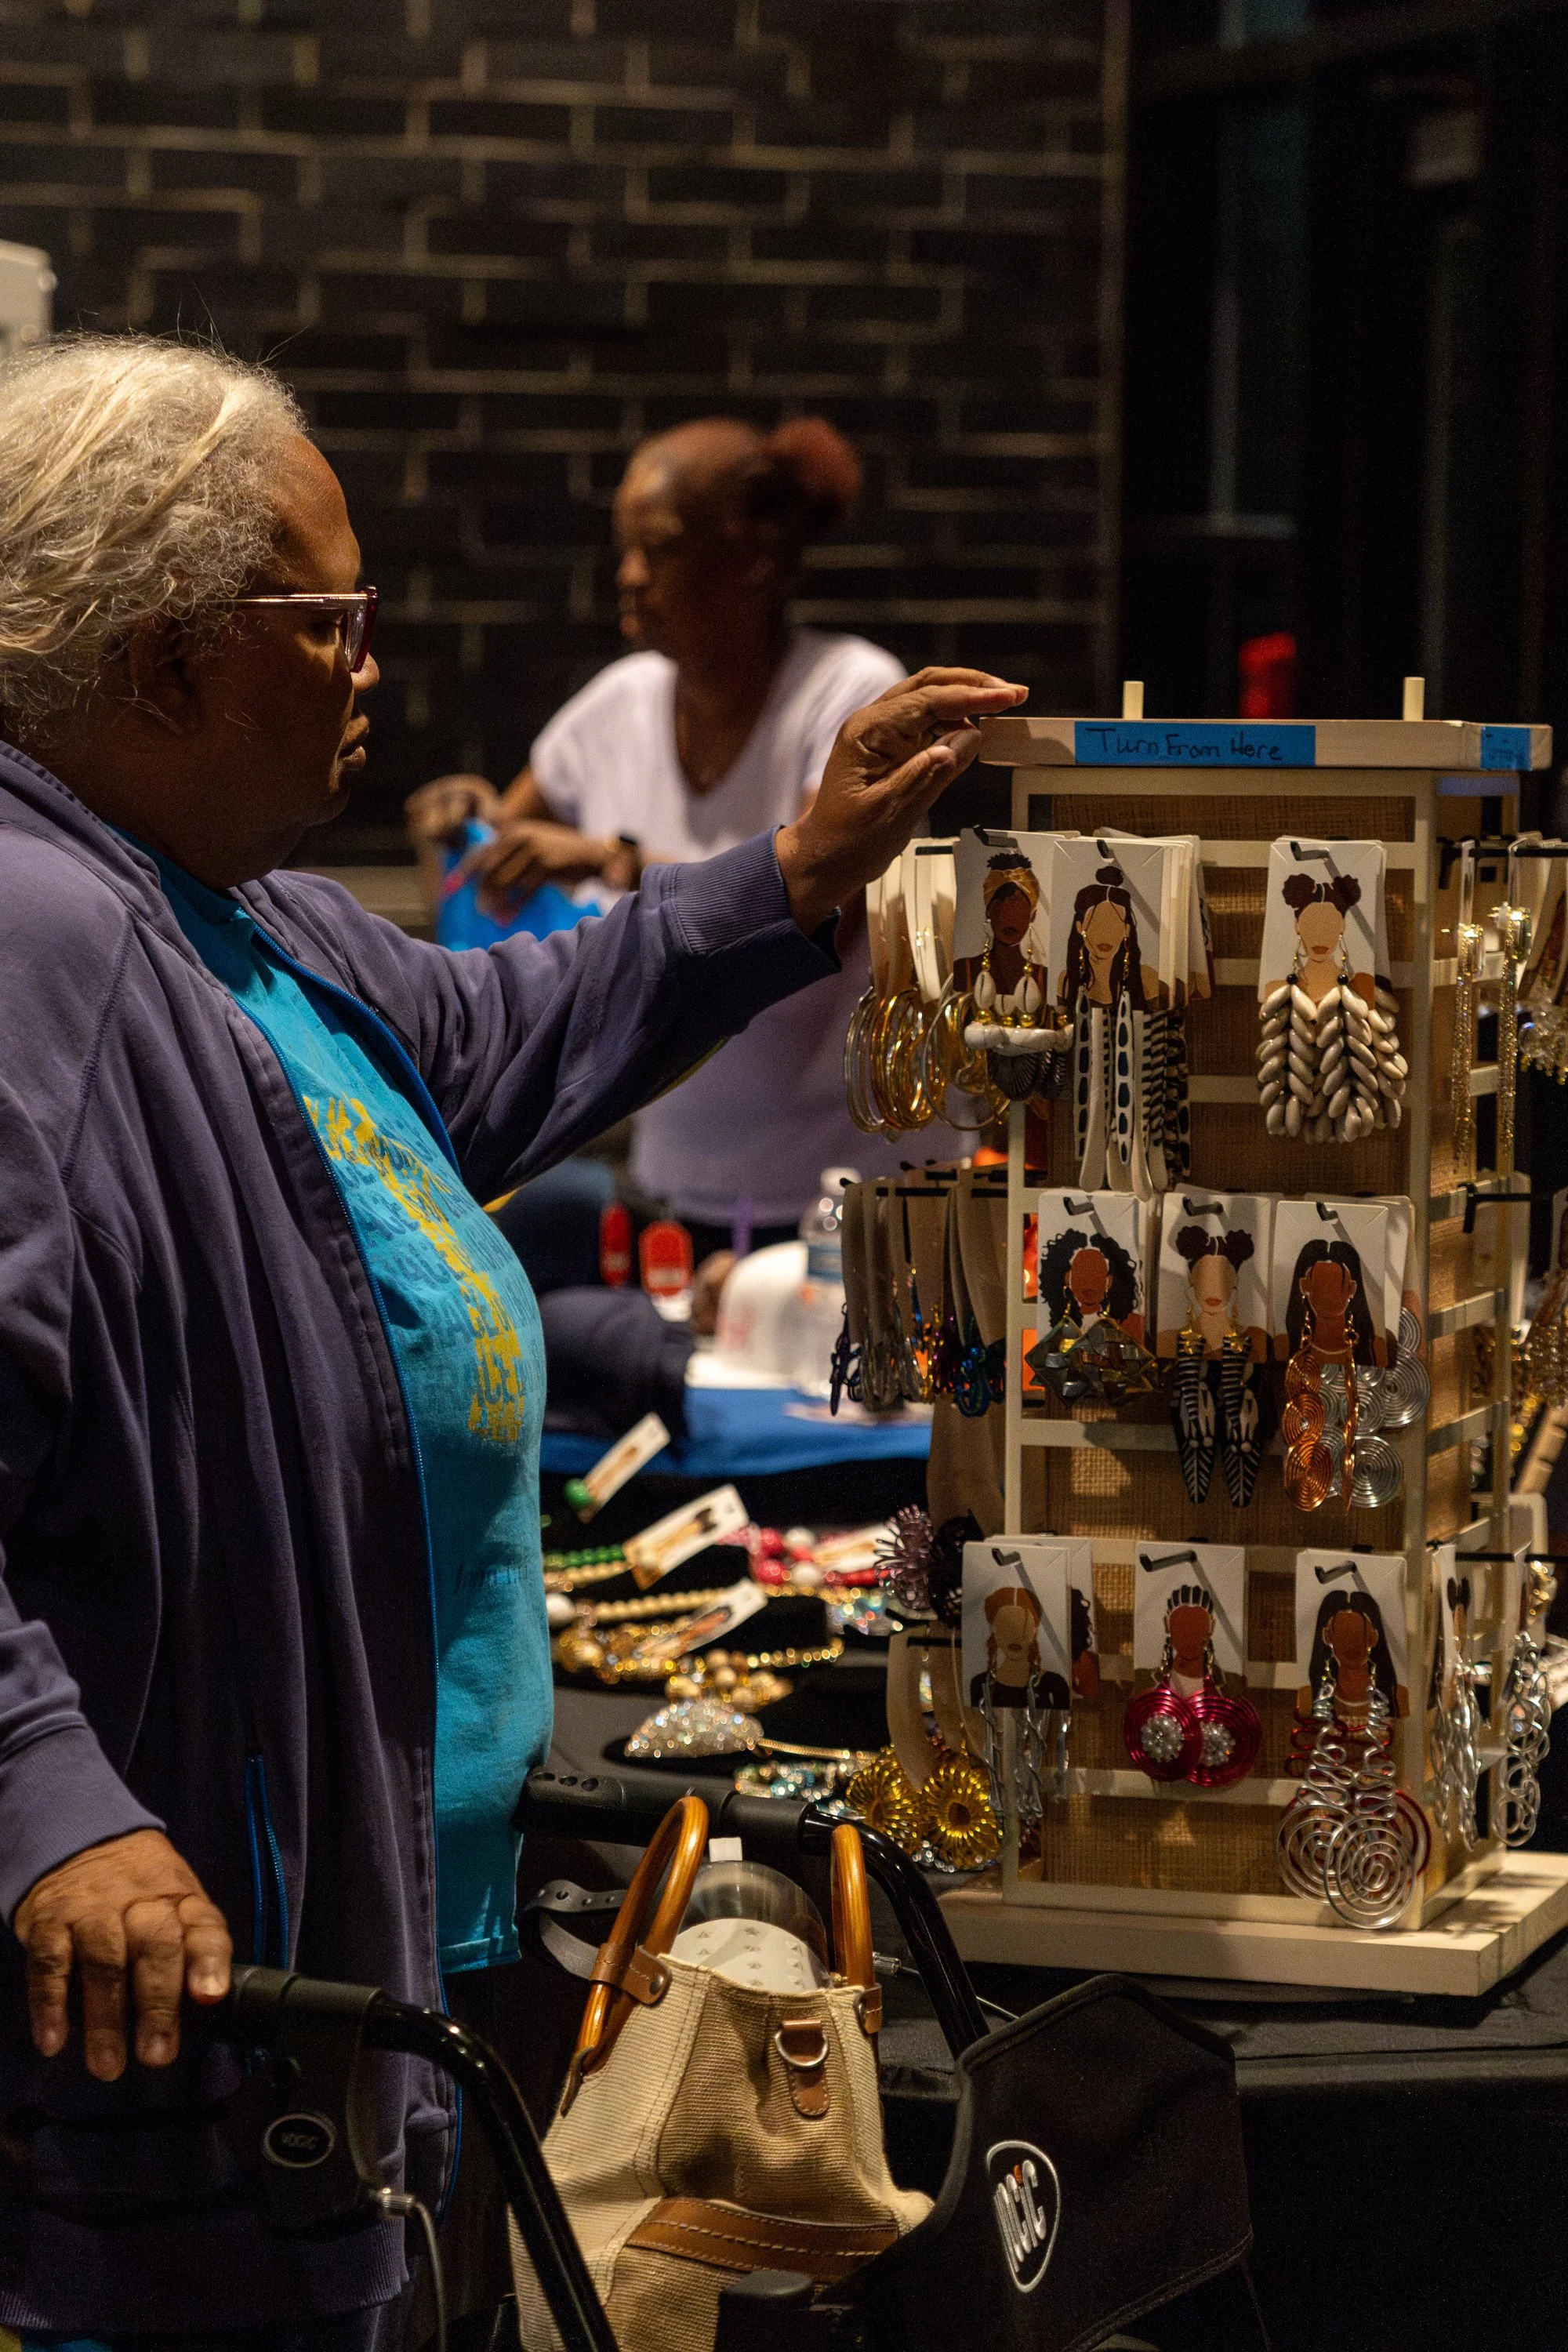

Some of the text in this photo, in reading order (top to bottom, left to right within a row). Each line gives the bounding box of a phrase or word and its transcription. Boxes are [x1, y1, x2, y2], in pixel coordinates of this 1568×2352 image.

[1084, 728, 1283, 761] Turn From Here
